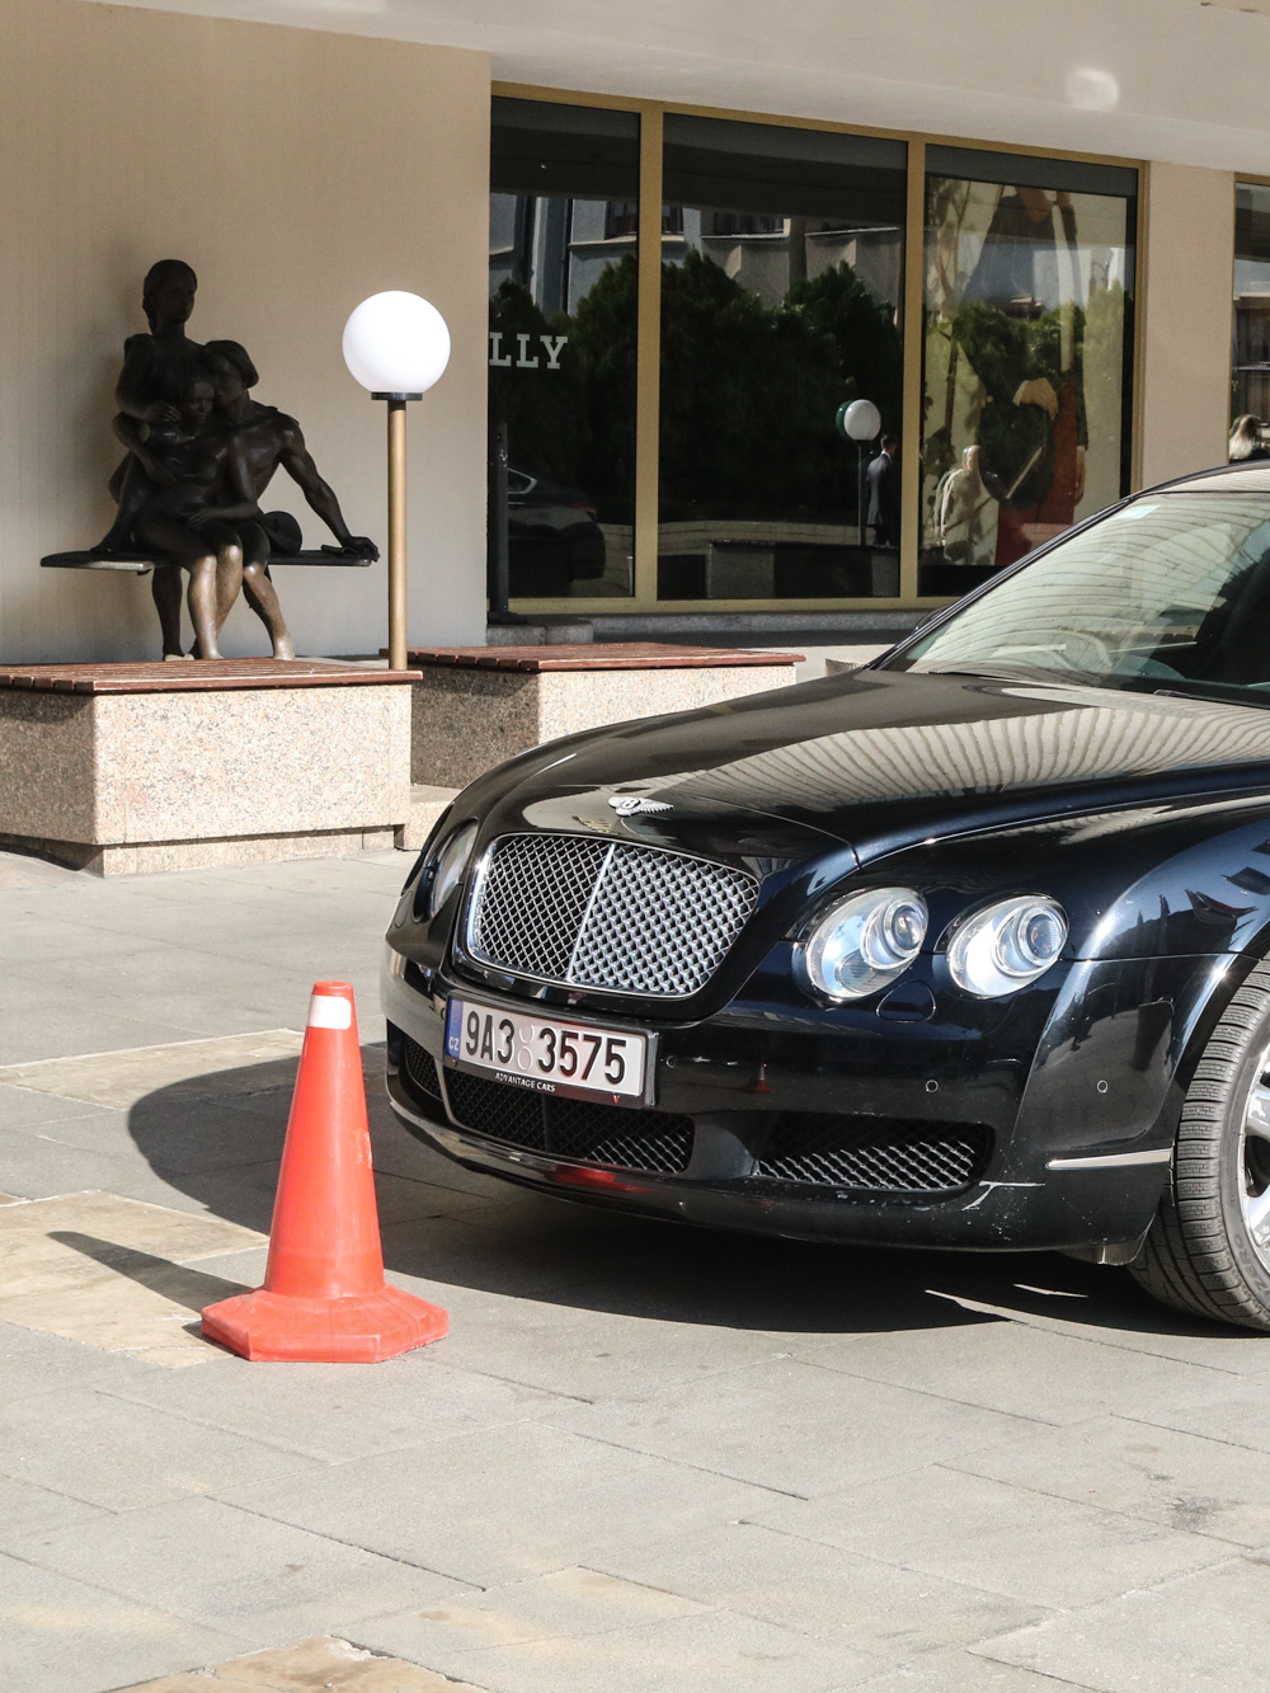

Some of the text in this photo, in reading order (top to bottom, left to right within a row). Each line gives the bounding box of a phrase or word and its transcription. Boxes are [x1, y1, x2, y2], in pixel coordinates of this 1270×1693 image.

[449, 1038, 460, 1051] CZ
[466, 1011, 627, 1084] 9A3 3575
[495, 1073, 556, 1093] ADVANTAGE CARS
